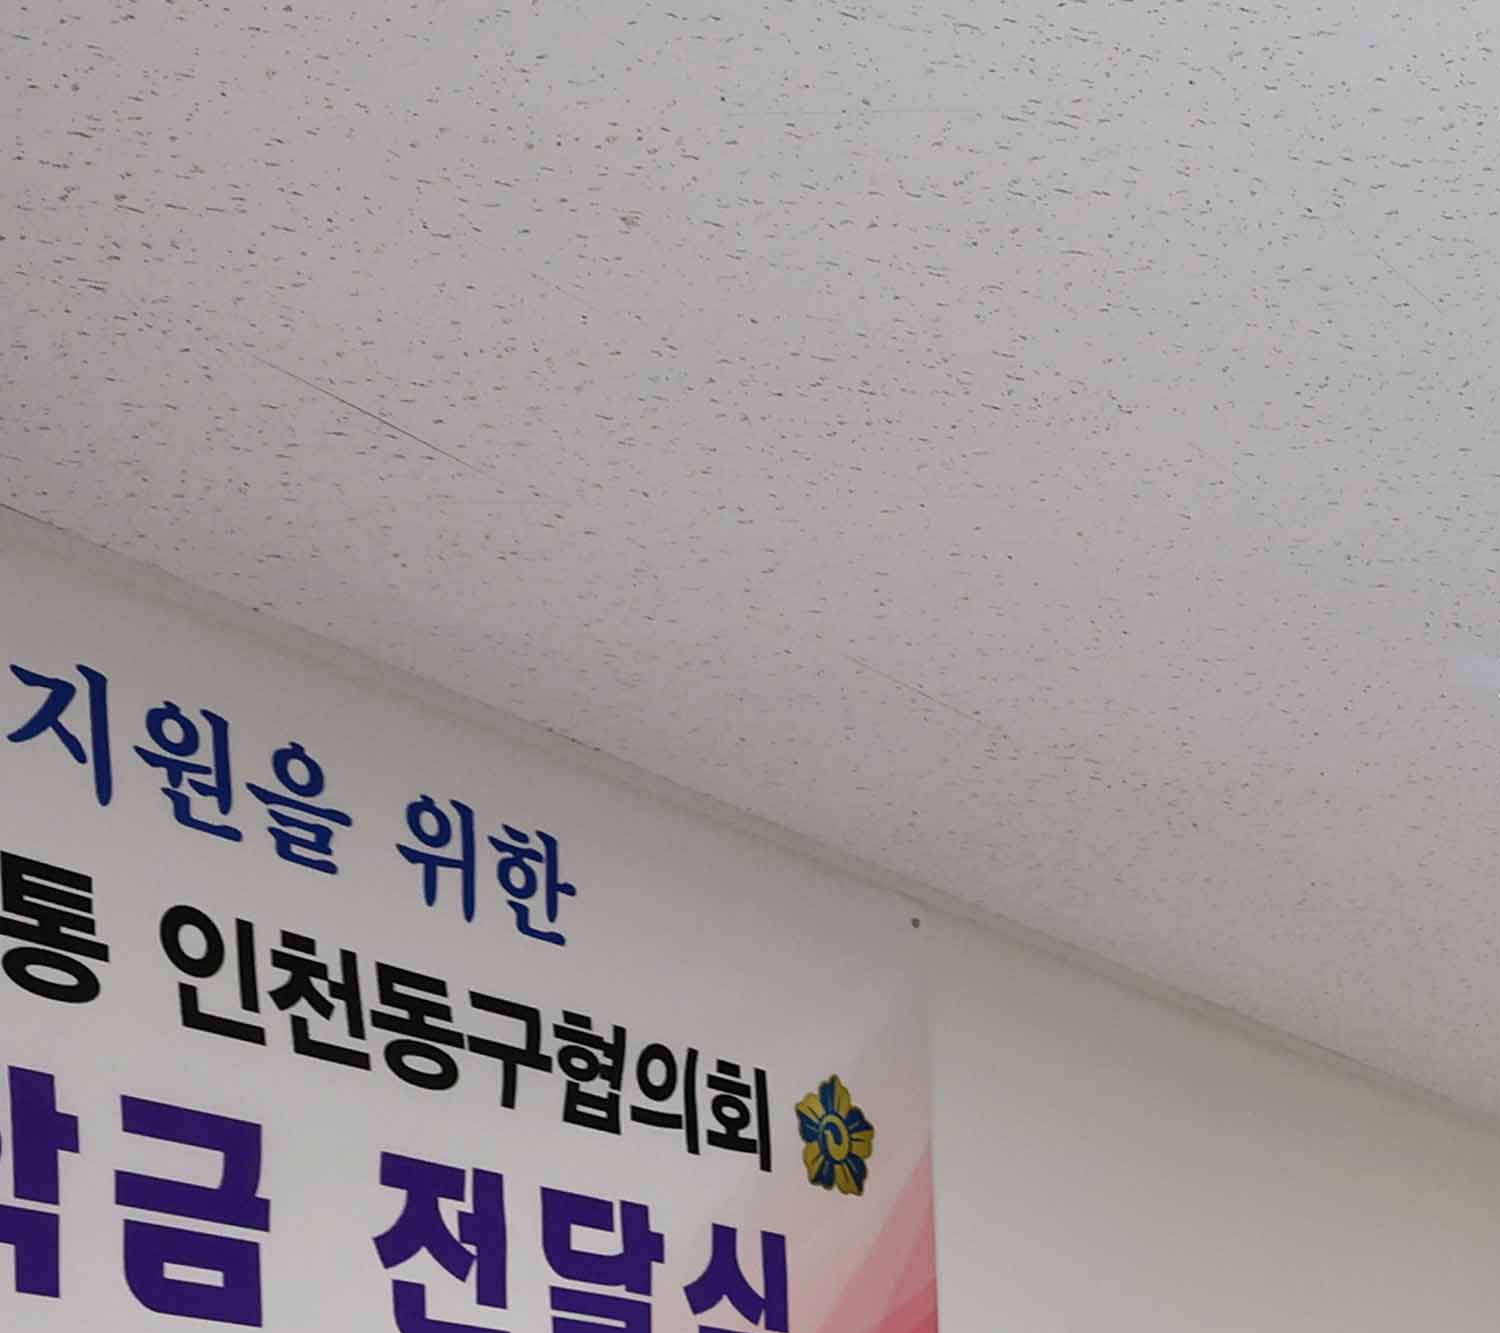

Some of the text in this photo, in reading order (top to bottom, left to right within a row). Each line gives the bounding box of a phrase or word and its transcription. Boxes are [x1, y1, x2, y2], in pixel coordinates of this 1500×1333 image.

[6, 664, 577, 946] 지원을 위한
[160, 904, 772, 1172] 인천동구협의회
